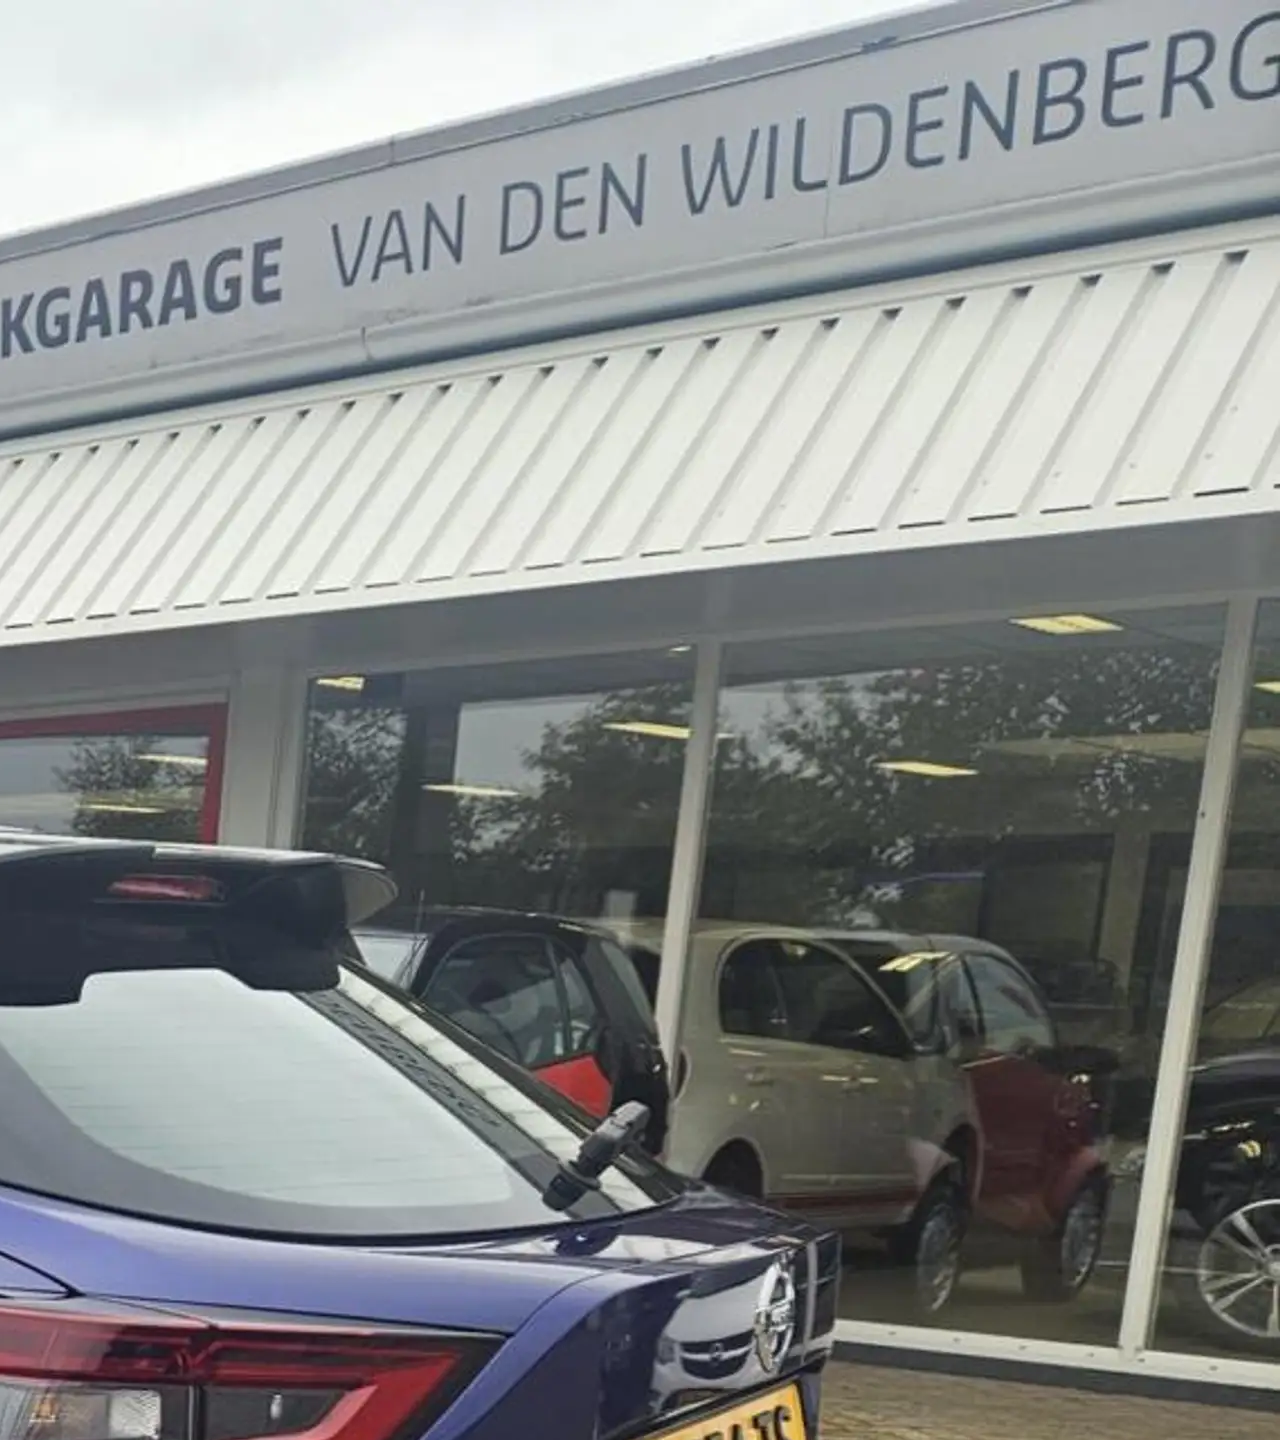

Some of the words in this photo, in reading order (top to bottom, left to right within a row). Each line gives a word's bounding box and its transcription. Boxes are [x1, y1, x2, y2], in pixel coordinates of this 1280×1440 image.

[330, 195, 467, 287] VAN
[498, 152, 648, 256] DEN
[680, 11, 1280, 217] WILDENBERG
